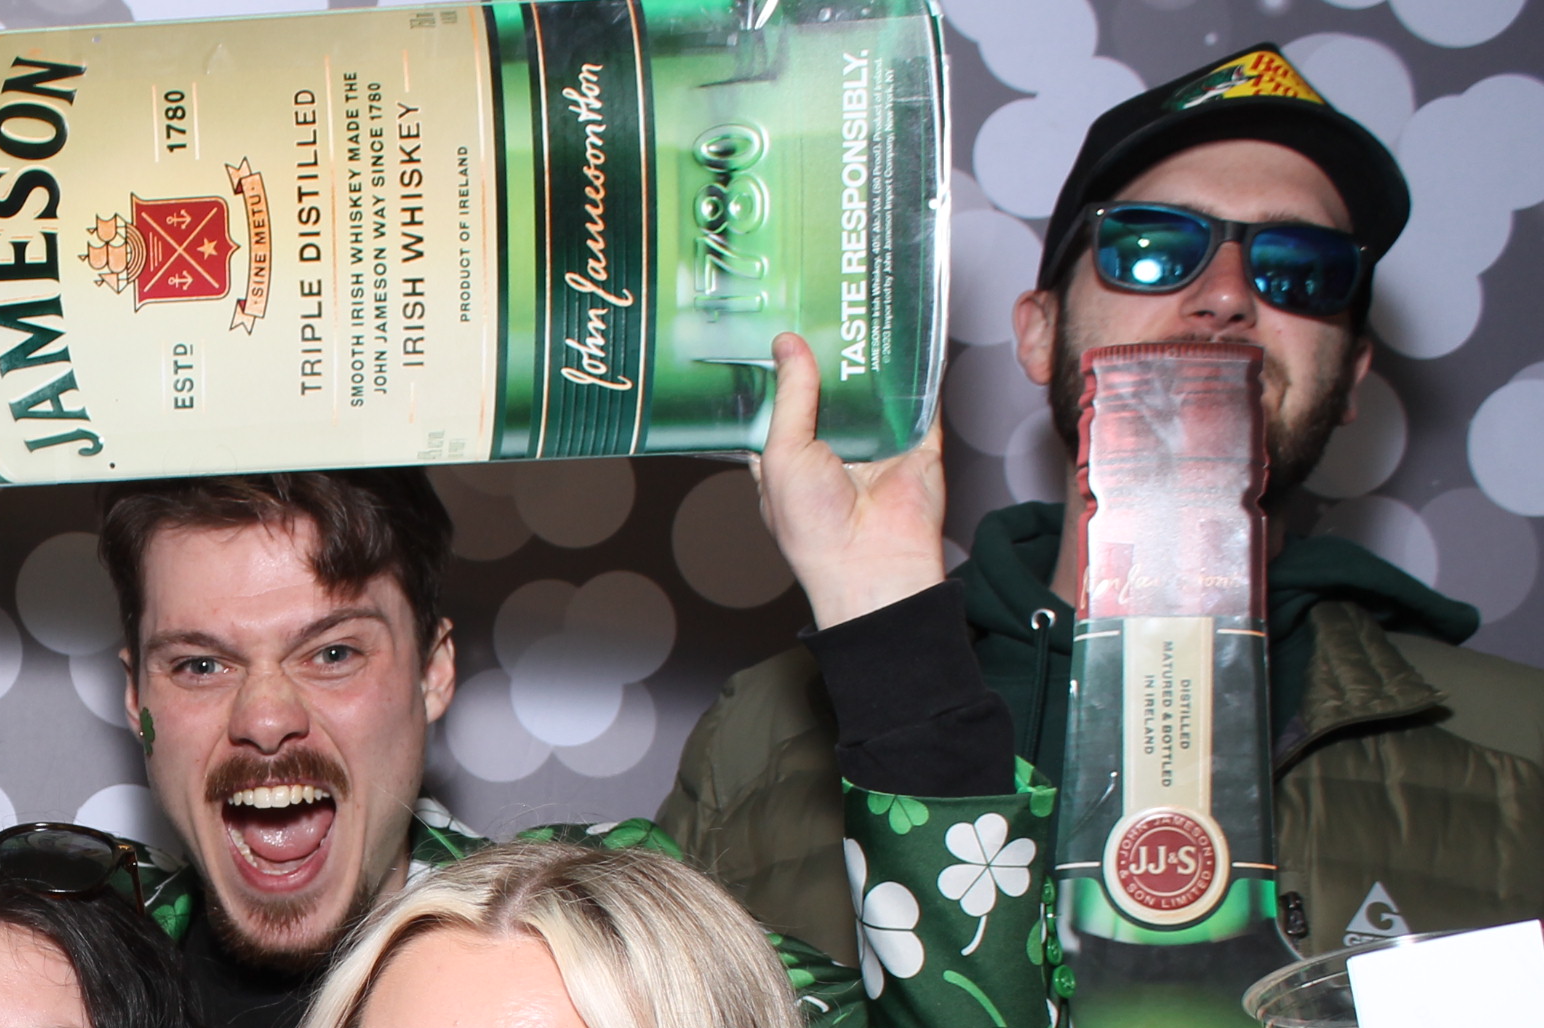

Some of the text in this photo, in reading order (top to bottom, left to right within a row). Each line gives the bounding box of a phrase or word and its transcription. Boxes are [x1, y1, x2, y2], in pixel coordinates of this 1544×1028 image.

[163, 89, 196, 410] ESTD 1780
[249, 193, 266, 298] SINE METU
[293, 89, 323, 396] TRIPLE DISTILLED
[343, 71, 365, 407] SMOOTH IRISH WHISKEY MADE THE
[367, 82, 388, 395] JOHN JAMESON WAY SINCE 1780
[396, 101, 425, 367] IRISH WHISKEY
[457, 146, 471, 323] PRODUCT OF IRELAND
[693, 123, 769, 323] 1780
[841, 48, 870, 381] TASTE RESPONSIBLY.
[1144, 674, 1155, 755] IN IRELAND
[1161, 641, 1173, 787] MATURED & BOTTLED
[1179, 679, 1191, 750] DISTILLED
[1119, 815, 1213, 857] JOHN JAMESON
[1126, 882, 1155, 906] SON
[1161, 870, 1211, 908] LIMITED
[1128, 845, 1197, 875] JJ&S
